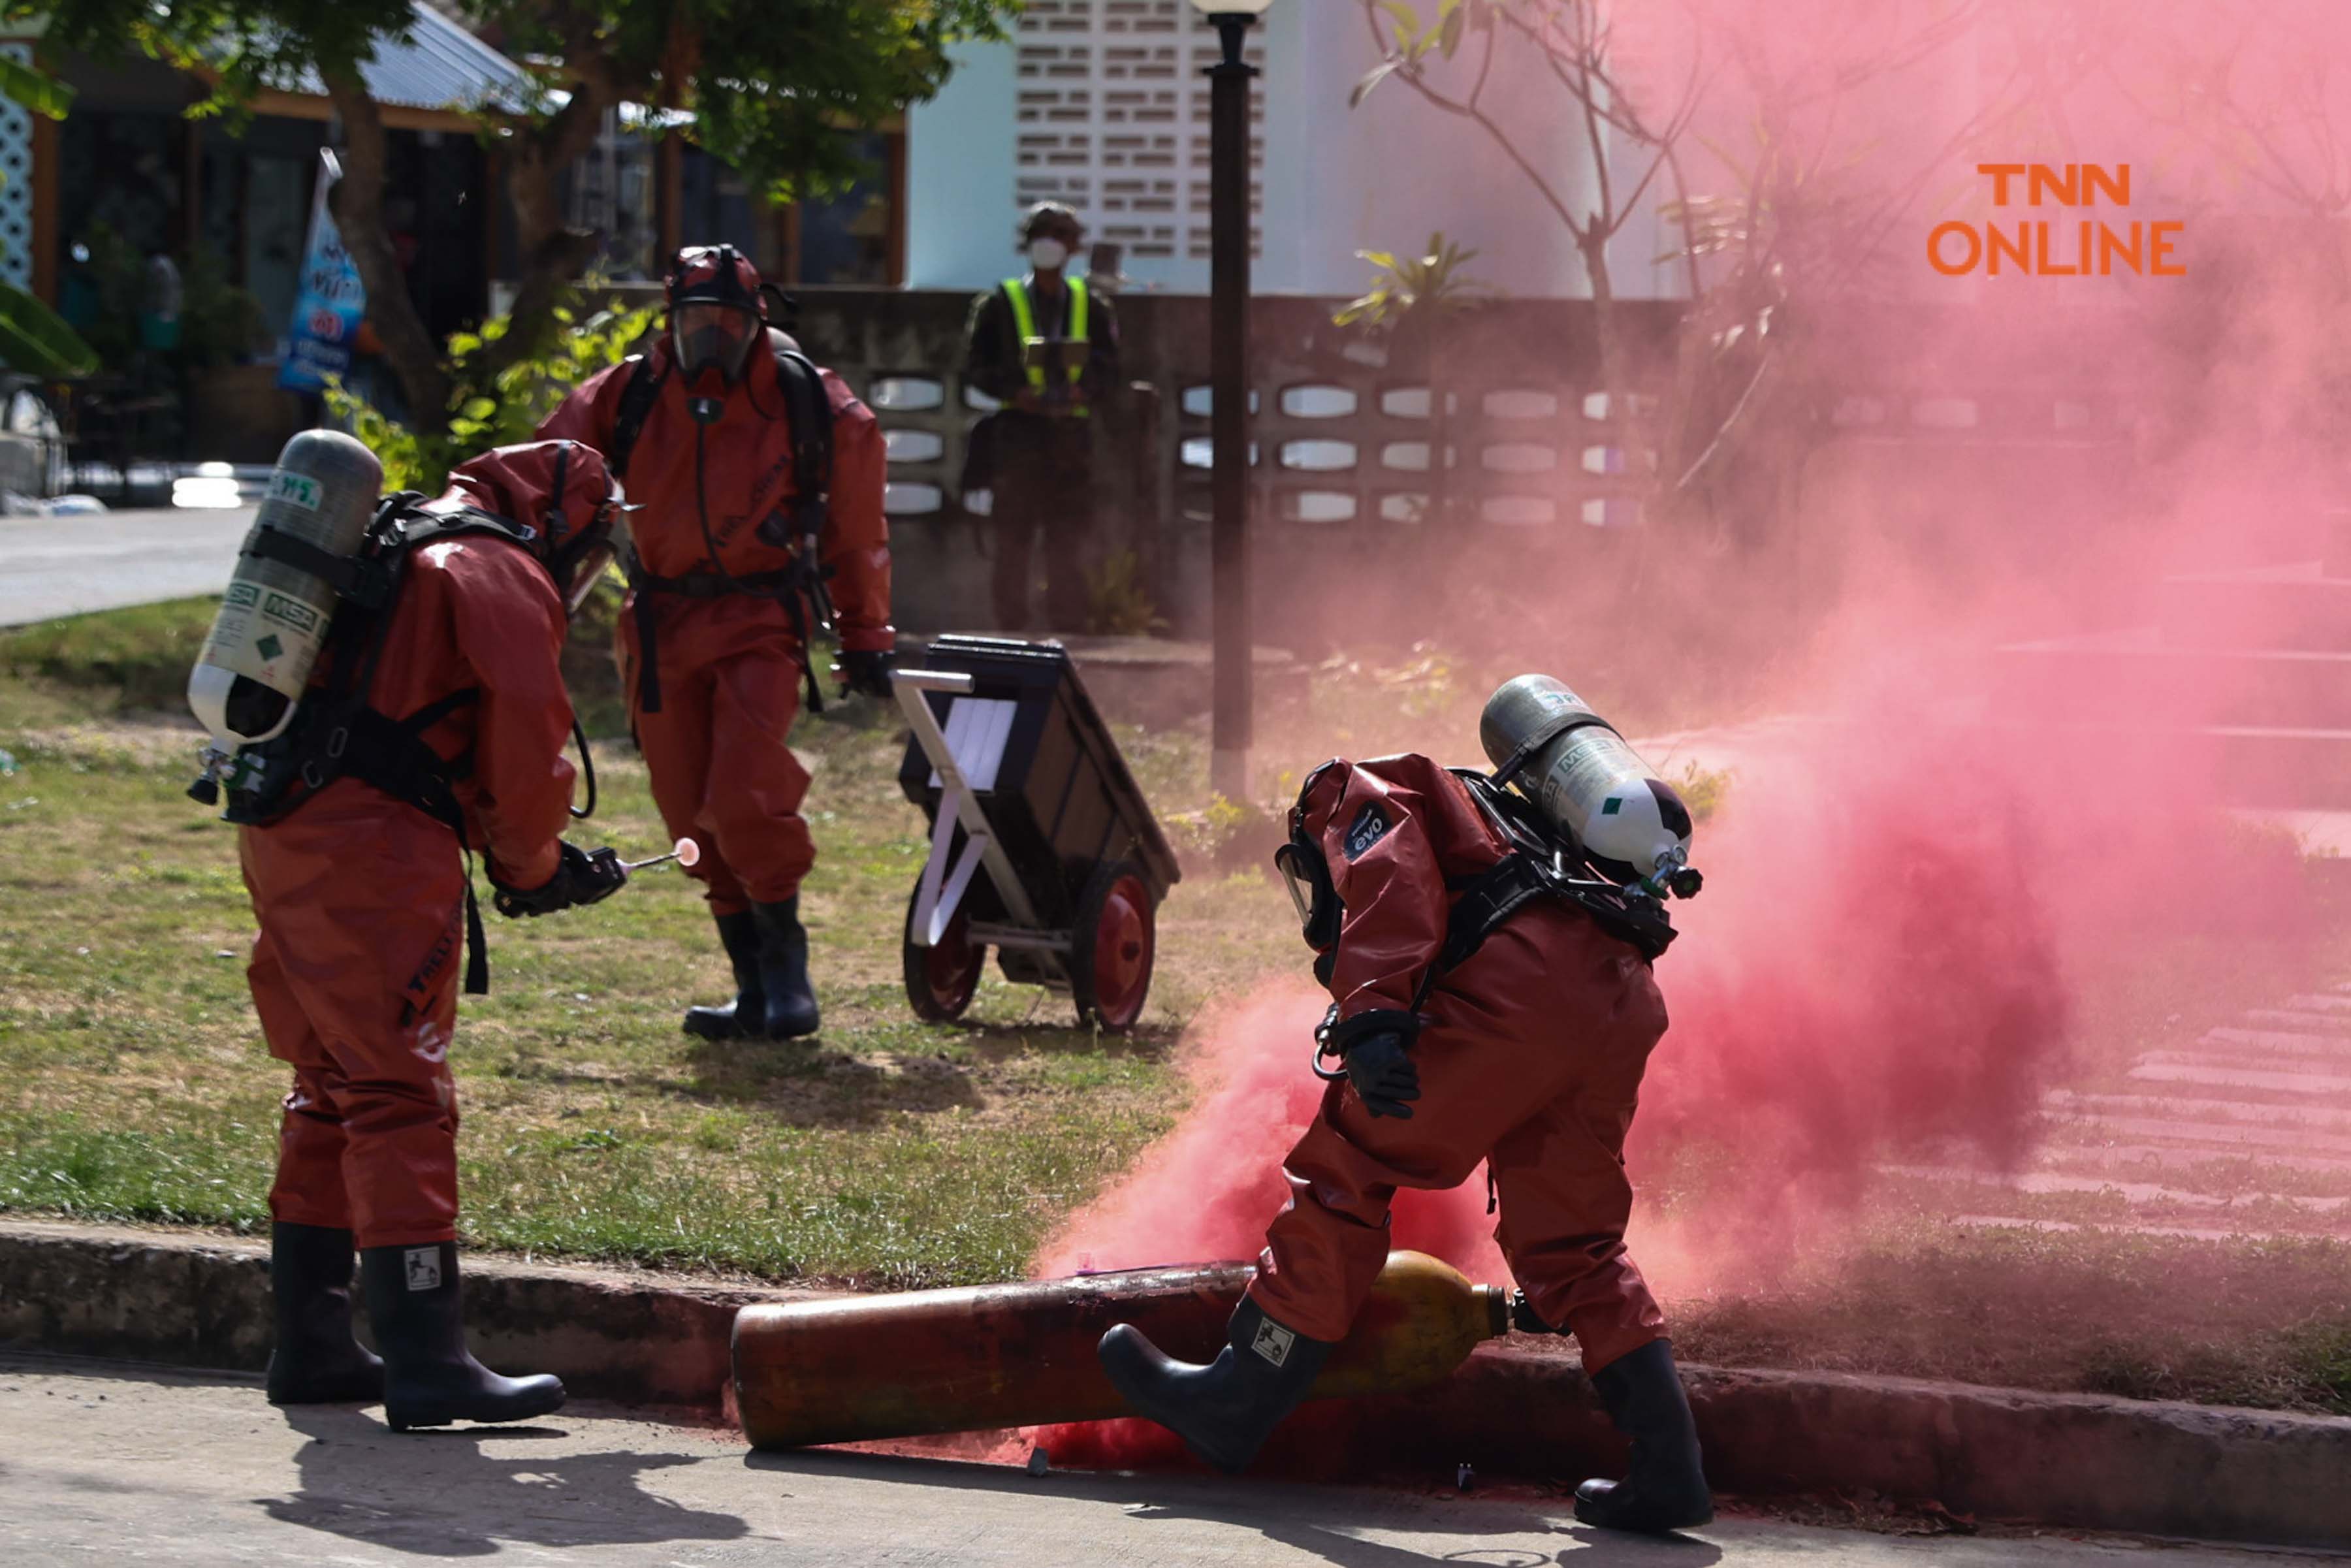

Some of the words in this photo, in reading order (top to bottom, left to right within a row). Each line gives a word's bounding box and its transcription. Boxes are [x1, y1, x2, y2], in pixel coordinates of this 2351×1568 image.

[267, 596, 315, 629] MSA
[1560, 739, 1614, 770] MSA
[1355, 818, 1383, 851] evo
